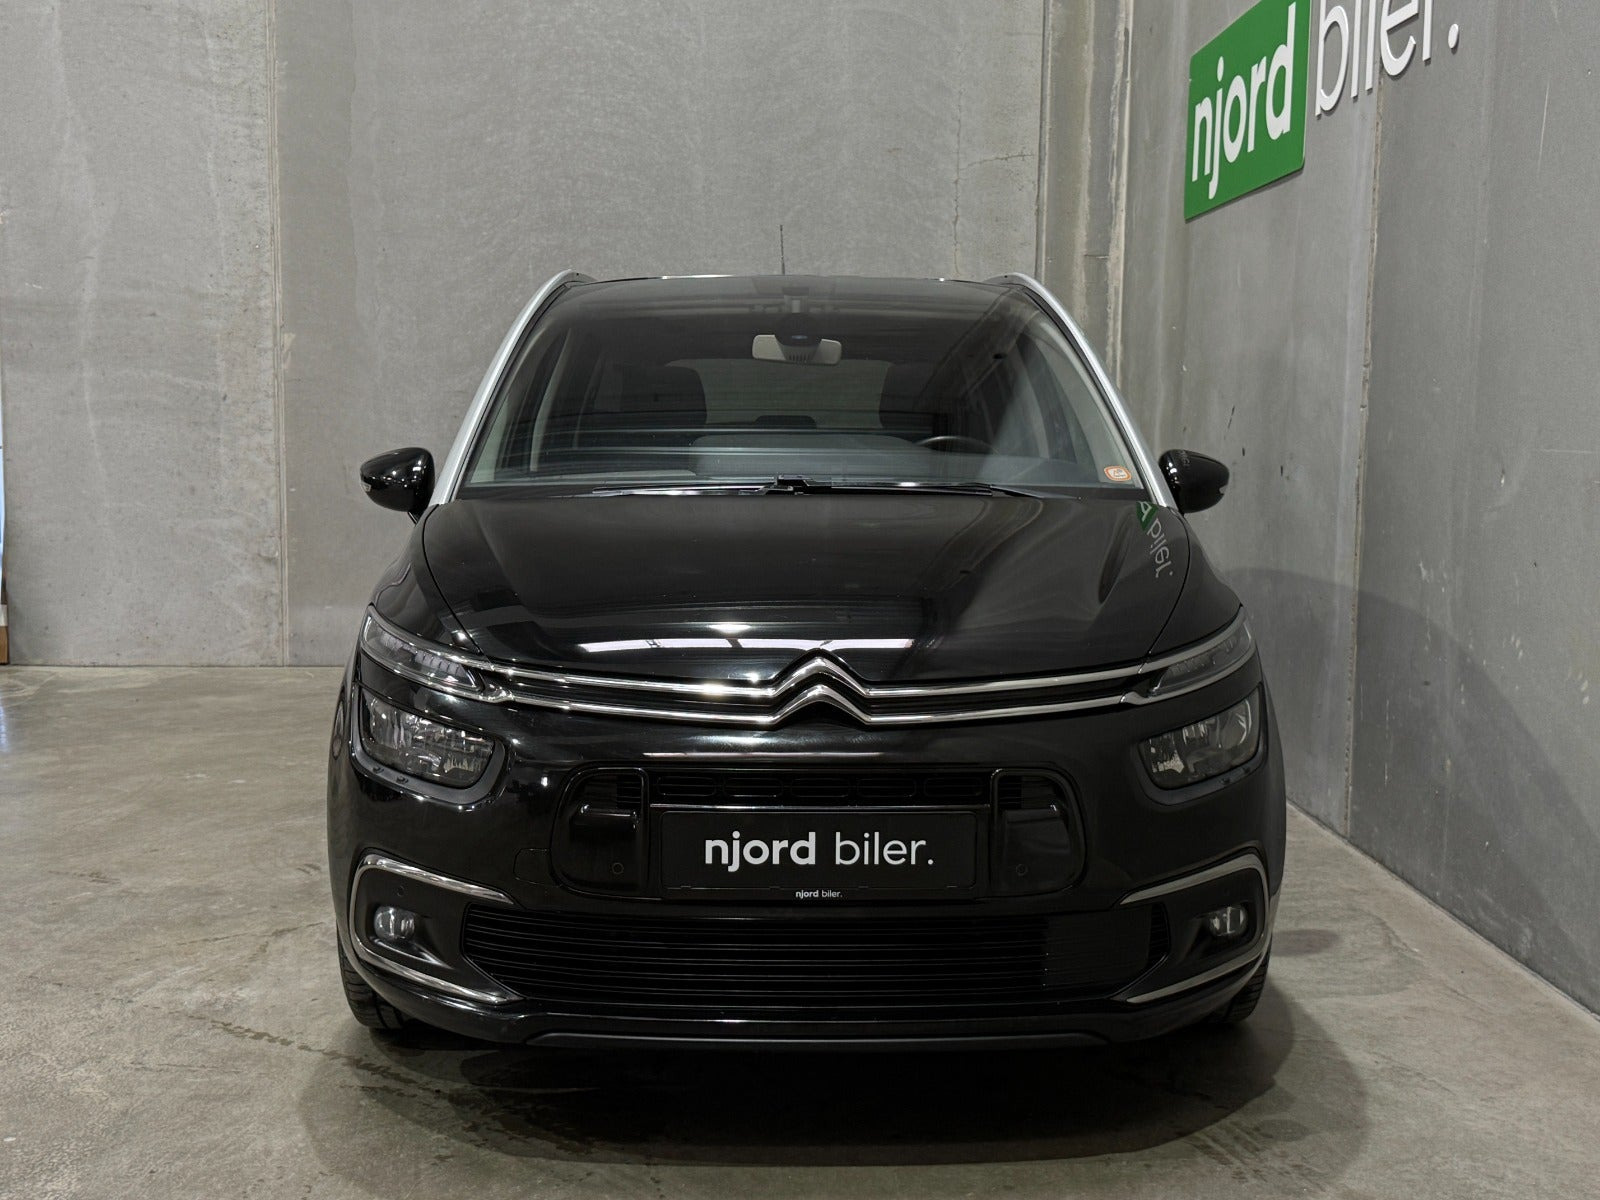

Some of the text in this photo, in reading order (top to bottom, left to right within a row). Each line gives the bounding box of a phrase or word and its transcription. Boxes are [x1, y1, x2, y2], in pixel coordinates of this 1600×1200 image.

[1191, 2, 1296, 200] njord
[705, 830, 934, 872] njord biler.
[795, 889, 843, 899] njord biler.
